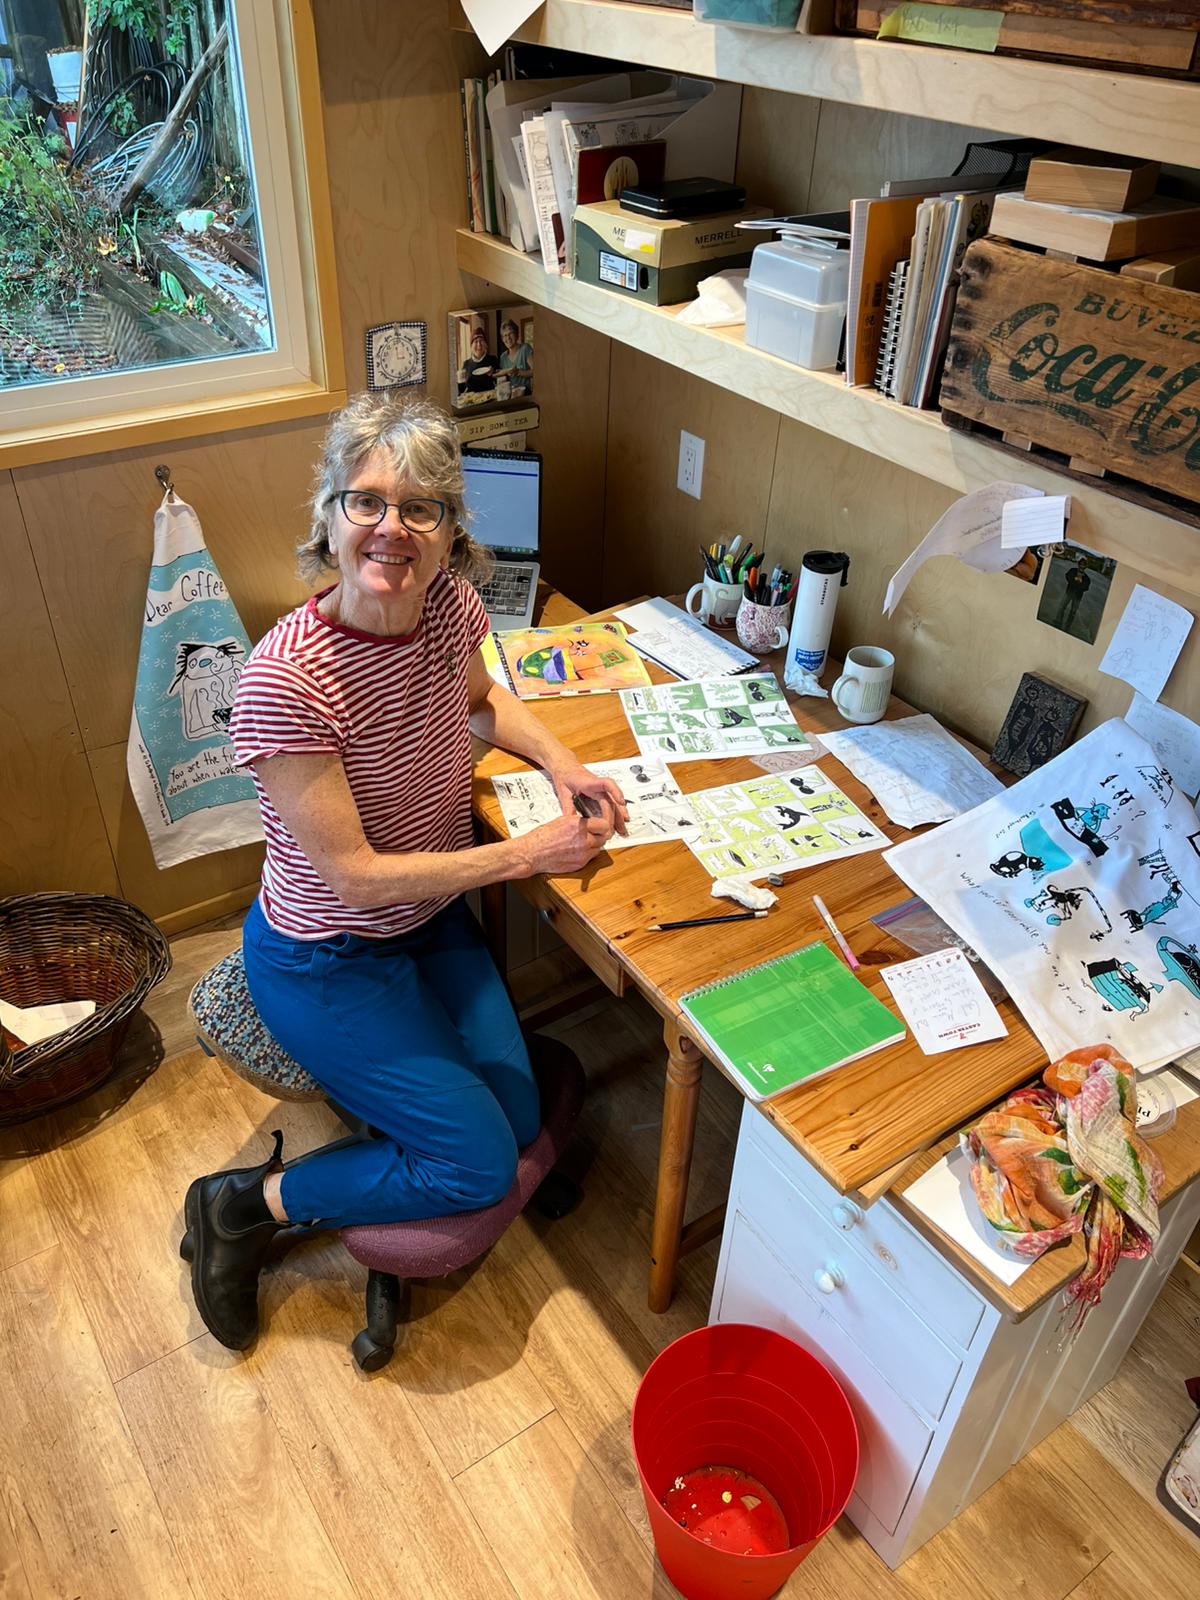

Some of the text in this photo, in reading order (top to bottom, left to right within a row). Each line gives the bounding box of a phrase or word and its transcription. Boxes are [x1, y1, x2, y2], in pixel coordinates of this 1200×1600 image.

[694, 228, 744, 245] MERRELL
[972, 302, 1200, 471] Coca-C
[145, 597, 173, 622] Dear
[168, 780, 189, 796] about
[192, 772, 211, 784] when
[219, 764, 240, 776] wake
[170, 746, 236, 782] You are the fir
[960, 872, 981, 889] What
[1020, 922, 1040, 939] while
